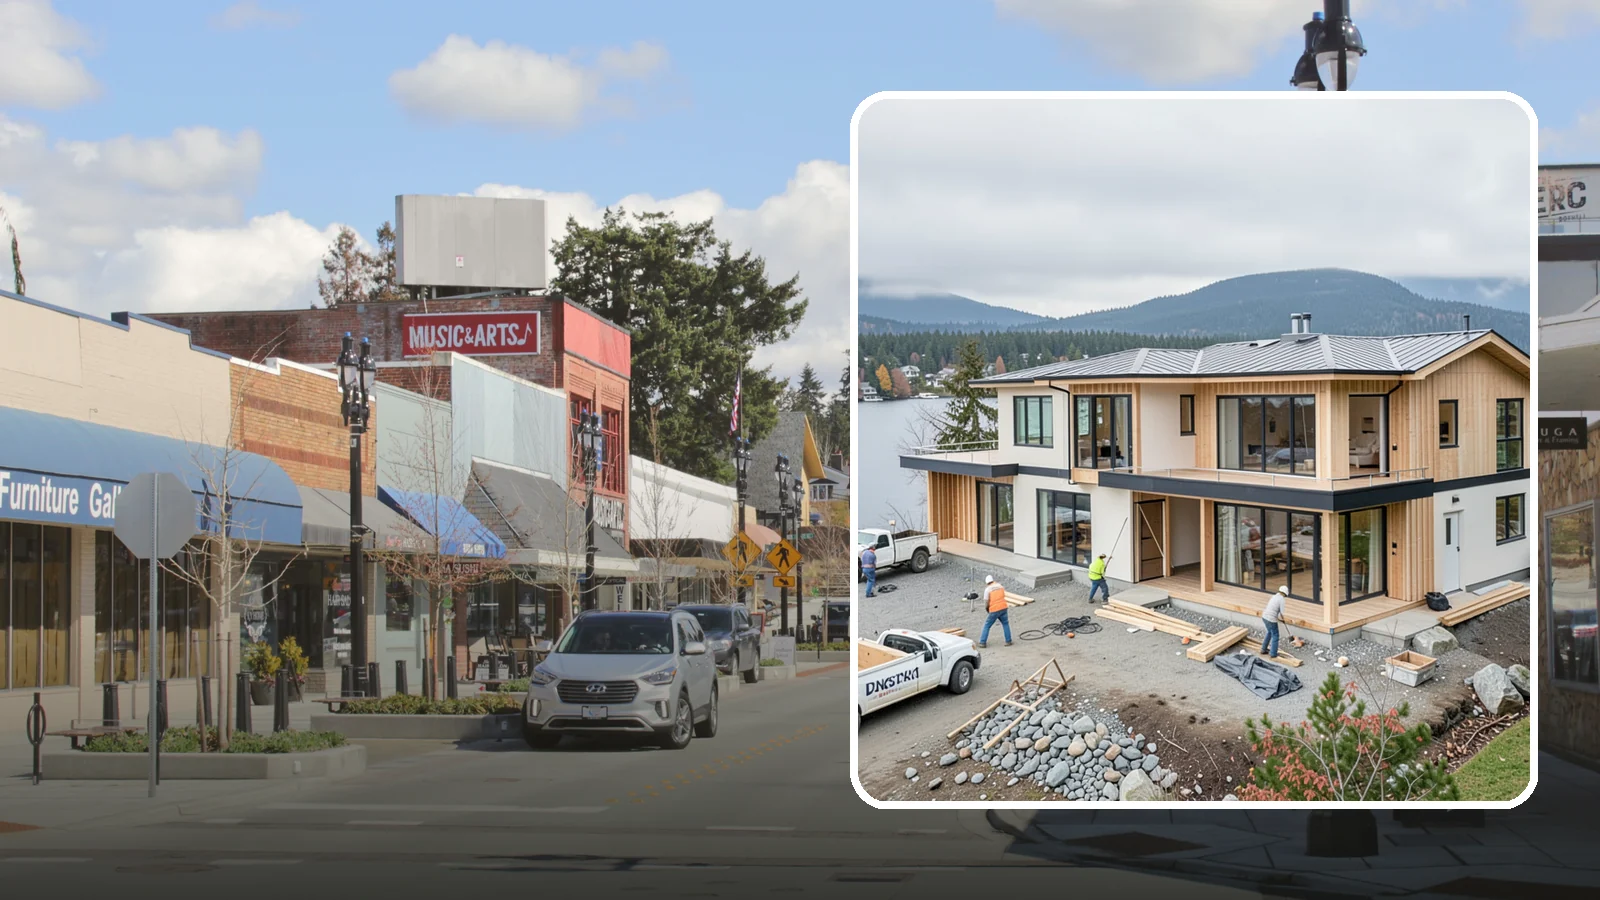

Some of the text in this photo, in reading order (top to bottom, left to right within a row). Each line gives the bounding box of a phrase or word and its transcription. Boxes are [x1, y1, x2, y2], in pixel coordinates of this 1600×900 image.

[0, 472, 121, 519] Furniture Gal
[454, 564, 479, 574] SUSHI
